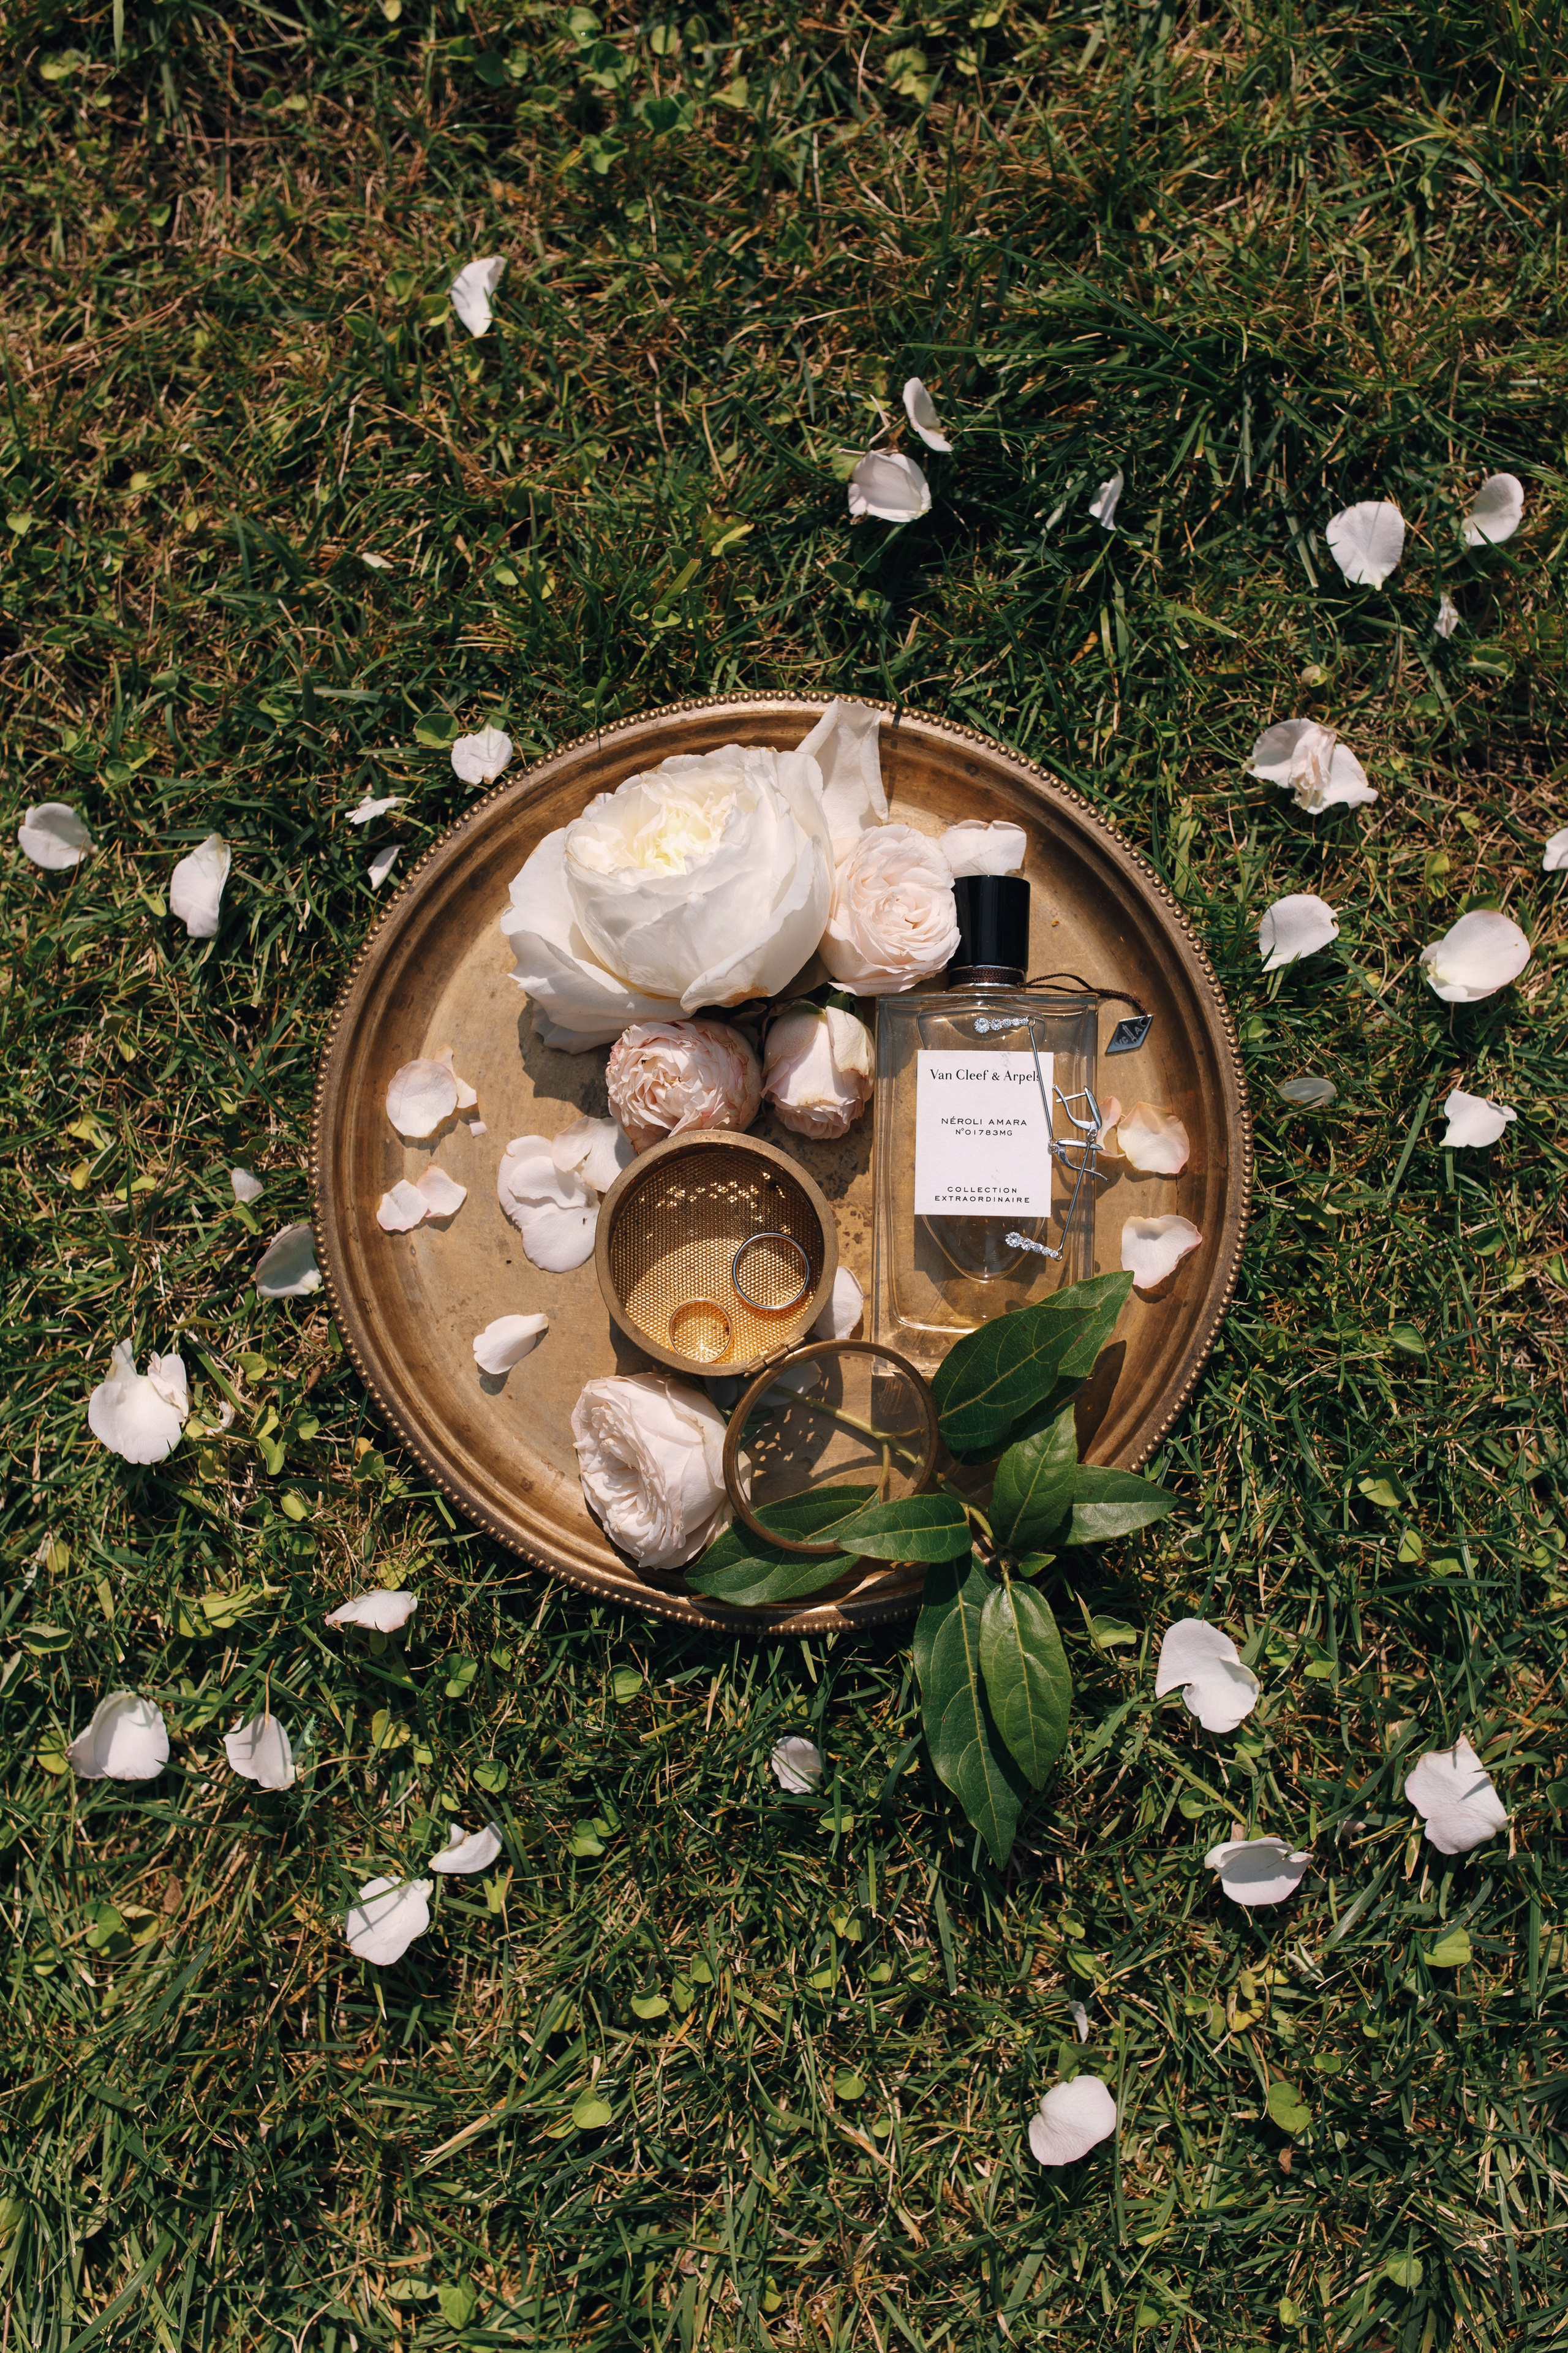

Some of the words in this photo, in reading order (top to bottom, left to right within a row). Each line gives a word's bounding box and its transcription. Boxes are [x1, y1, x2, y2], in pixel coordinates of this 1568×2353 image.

[930, 1069, 952, 1080] Van
[956, 1069, 989, 1081] Cleef
[992, 1072, 1000, 1081] &
[941, 1116, 982, 1125] NÉROLI
